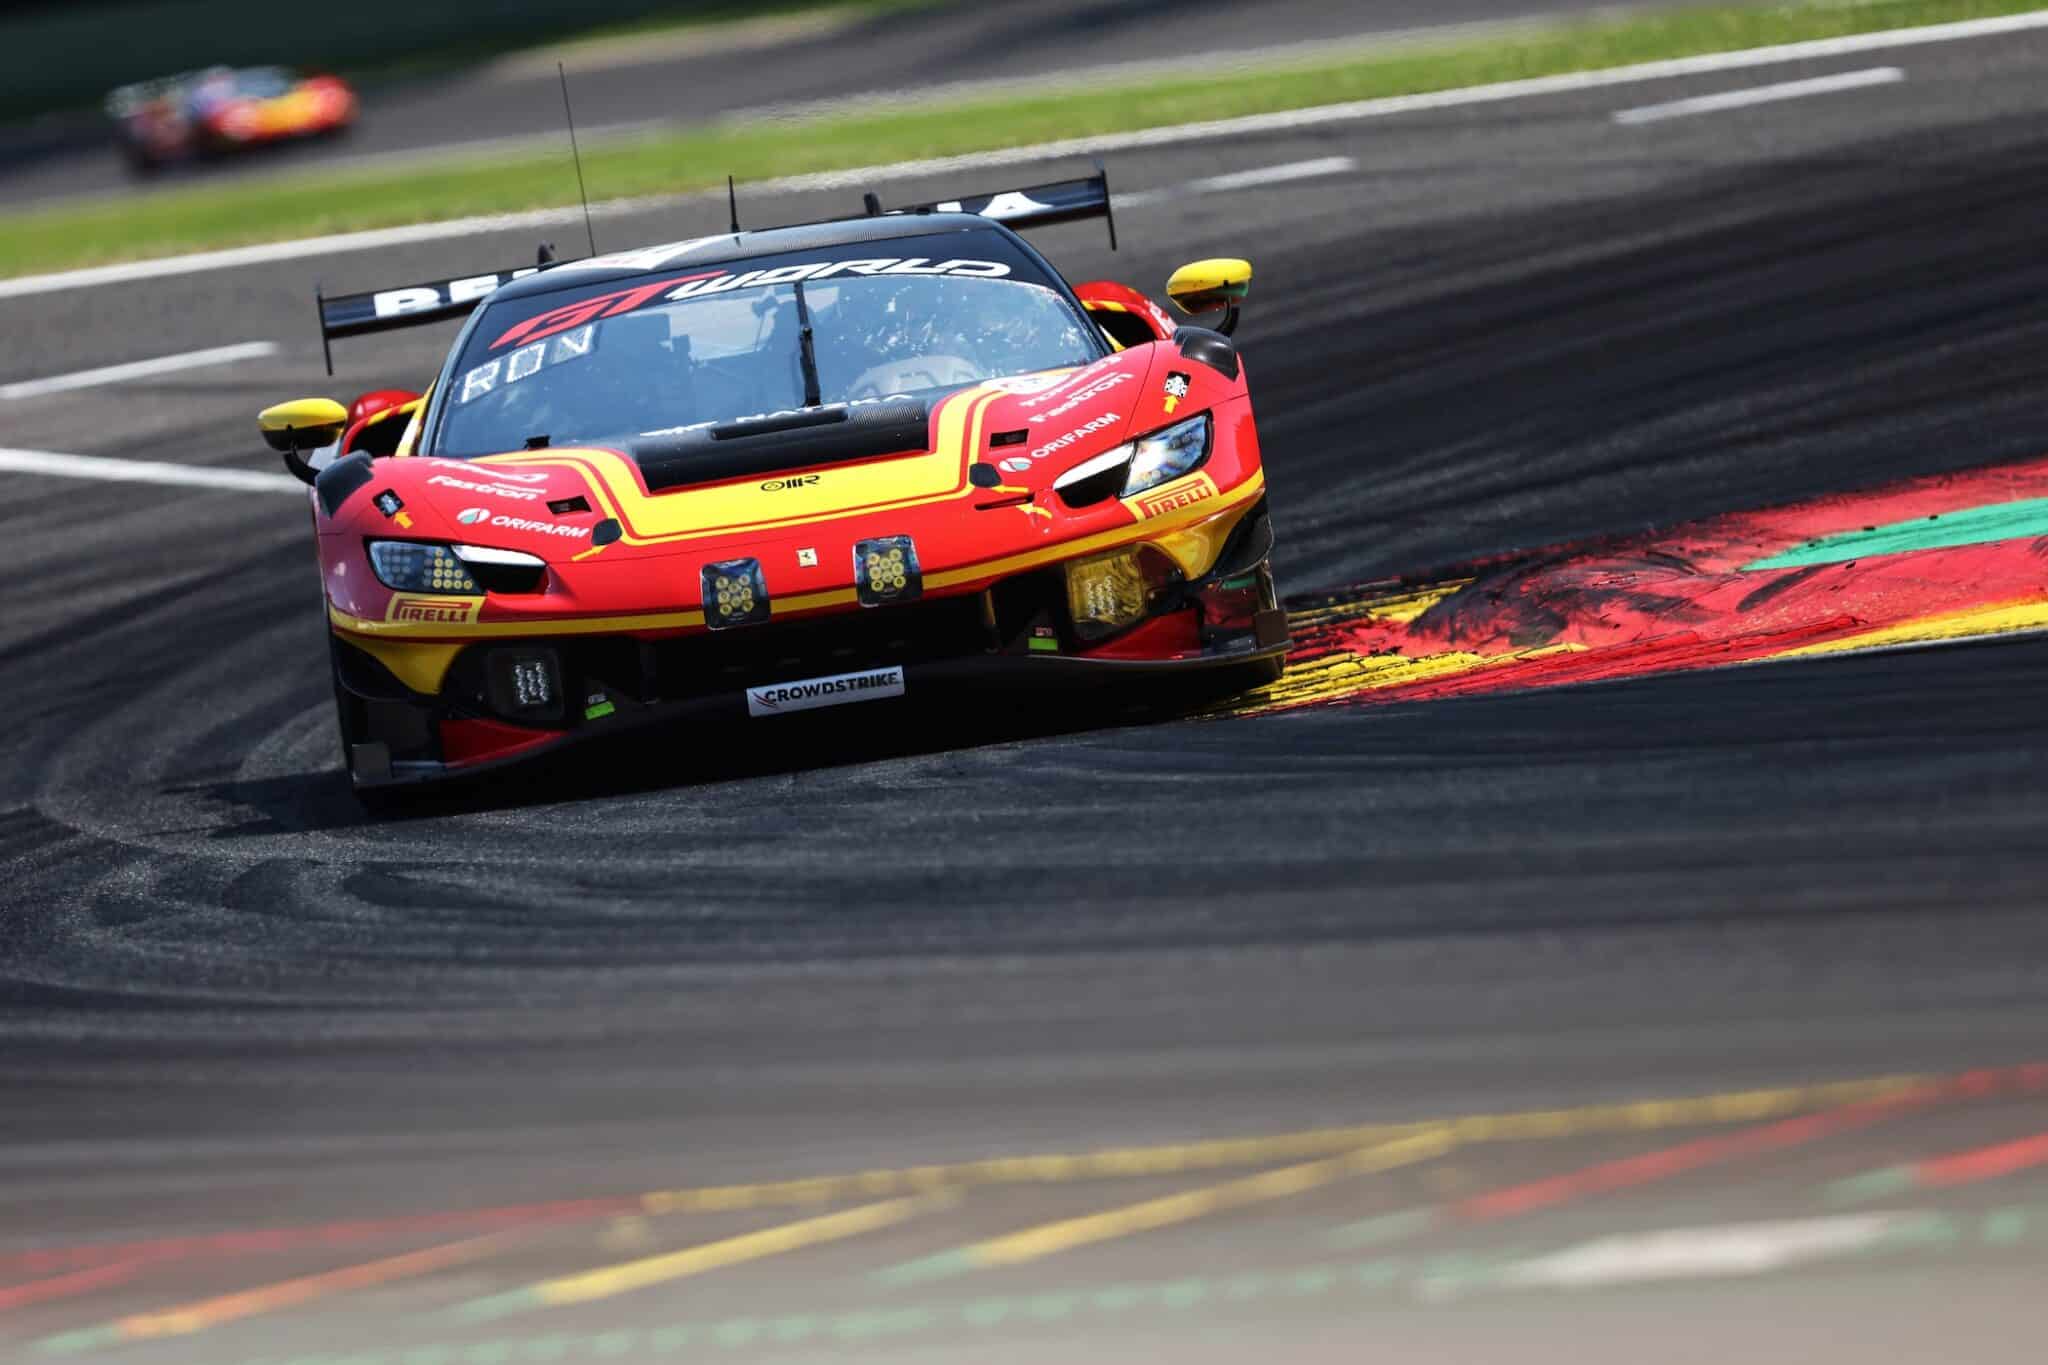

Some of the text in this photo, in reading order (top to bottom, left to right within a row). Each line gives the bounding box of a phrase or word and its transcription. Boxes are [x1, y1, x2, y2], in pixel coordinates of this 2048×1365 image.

[663, 257, 1012, 301] WORLD
[1030, 411, 1122, 460] ORIFARM
[1133, 478, 1213, 520] PIRELLI
[490, 514, 590, 539] ORIFARM
[391, 598, 473, 624] PIRELLI
[764, 671, 900, 704] CROWDSTRIKE
